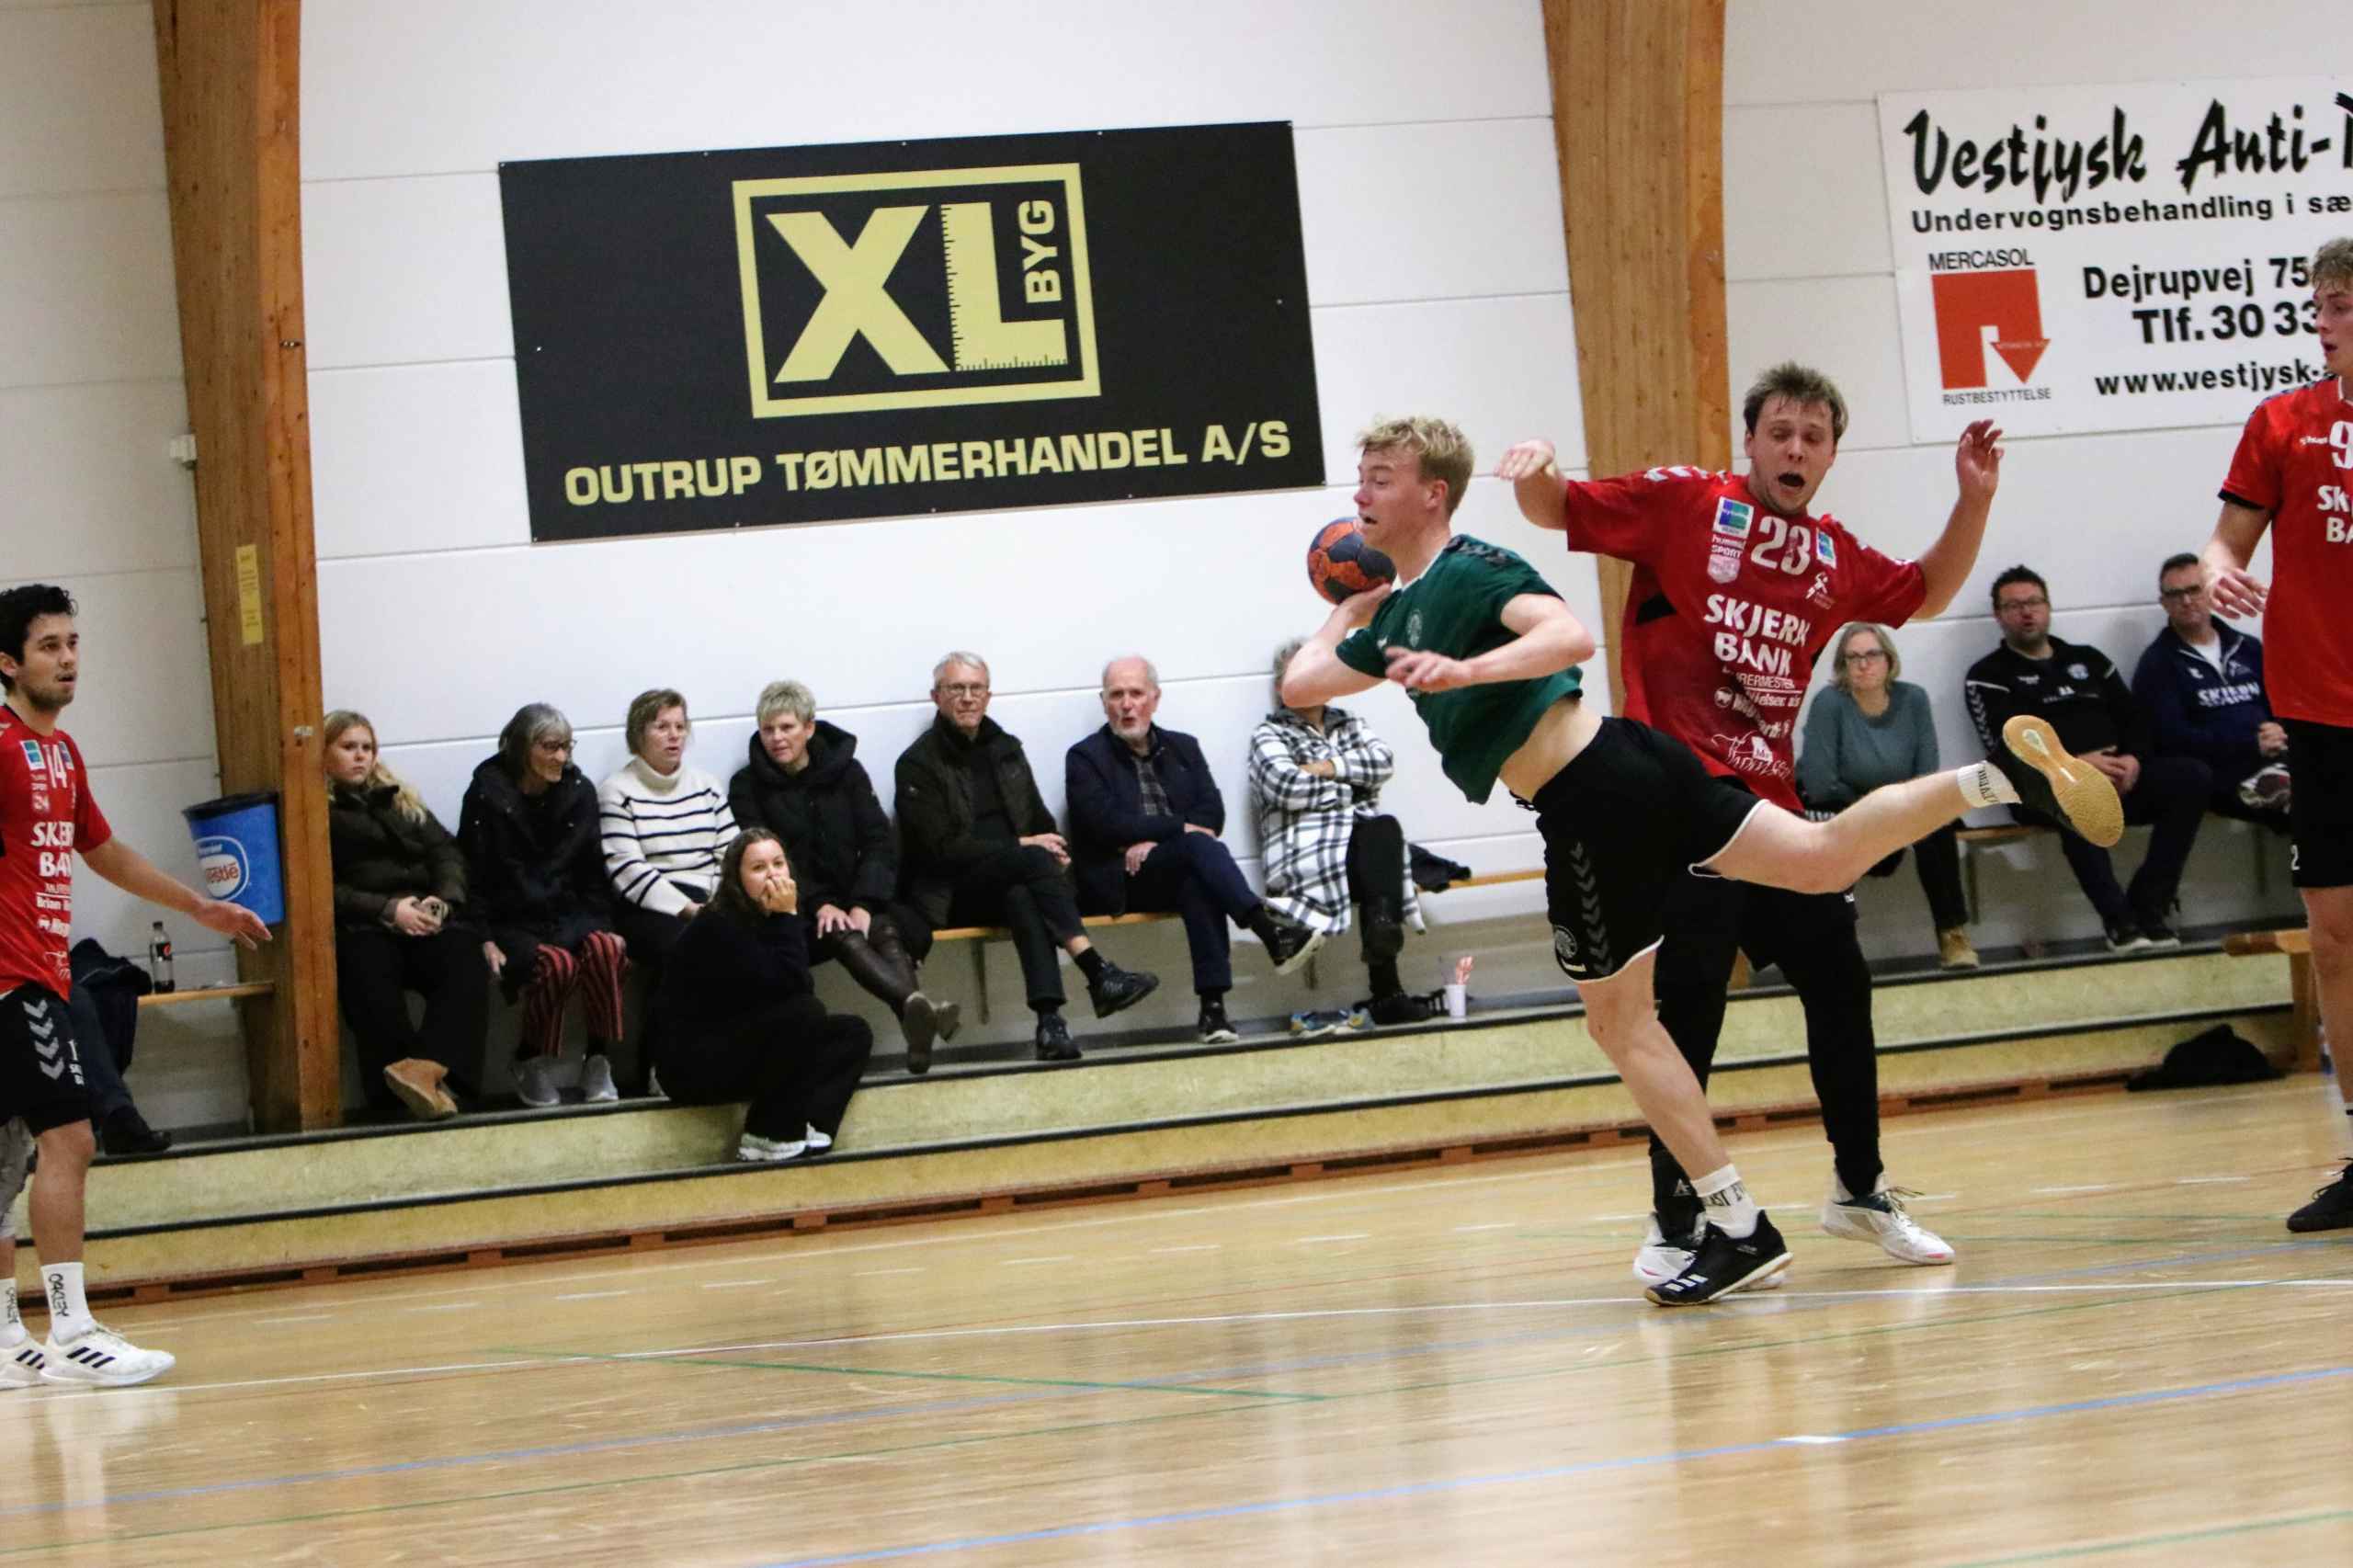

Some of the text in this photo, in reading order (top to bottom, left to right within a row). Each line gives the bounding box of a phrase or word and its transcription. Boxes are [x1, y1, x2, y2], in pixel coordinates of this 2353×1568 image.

[1903, 106, 2148, 204] Vestjysk
[1912, 196, 2273, 233] Undervognsbehandling
[2286, 192, 2294, 214] i
[1017, 199, 1062, 304] BYG
[1928, 248, 2034, 272] MERCASOL
[766, 201, 1069, 383] XL
[2083, 258, 2254, 301] Dejrupvej
[2132, 305, 2204, 344] Tlf.
[2211, 303, 2265, 341] 30
[1943, 387, 2052, 405] RUSTBESTYTTELSE
[2095, 358, 2328, 397] www.vestjysk-
[564, 419, 1291, 506] OUTRUP TØMMERHANDEL A/S
[2317, 485, 2353, 515] SK
[1750, 516, 1811, 575] 23
[1714, 631, 1792, 677] BANK
[42, 744, 67, 789] 14
